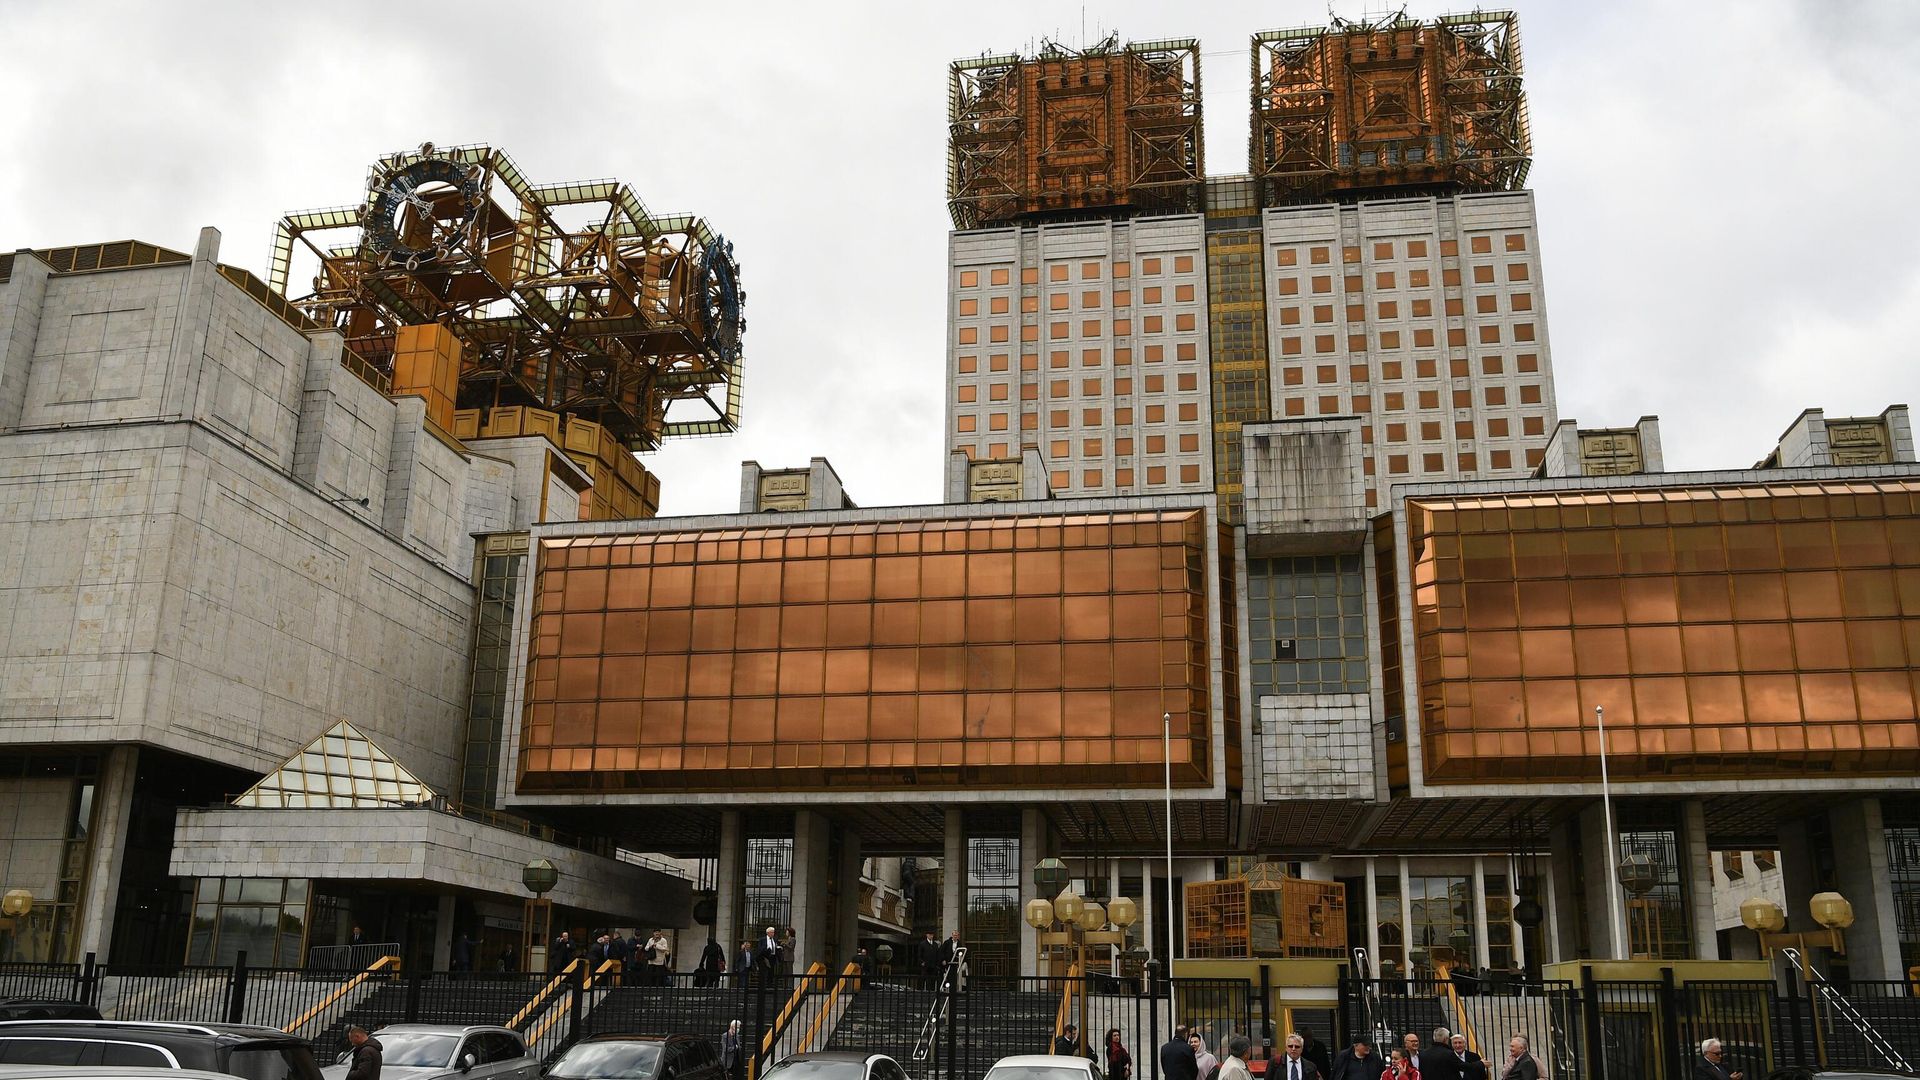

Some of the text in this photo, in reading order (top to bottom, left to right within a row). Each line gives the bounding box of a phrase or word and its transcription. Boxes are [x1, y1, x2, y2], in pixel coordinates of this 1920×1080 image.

[467, 163, 481, 181] 2
[472, 191, 485, 210] 3
[358, 203, 369, 220] 9
[361, 229, 372, 248] 8
[405, 252, 420, 270] 6
